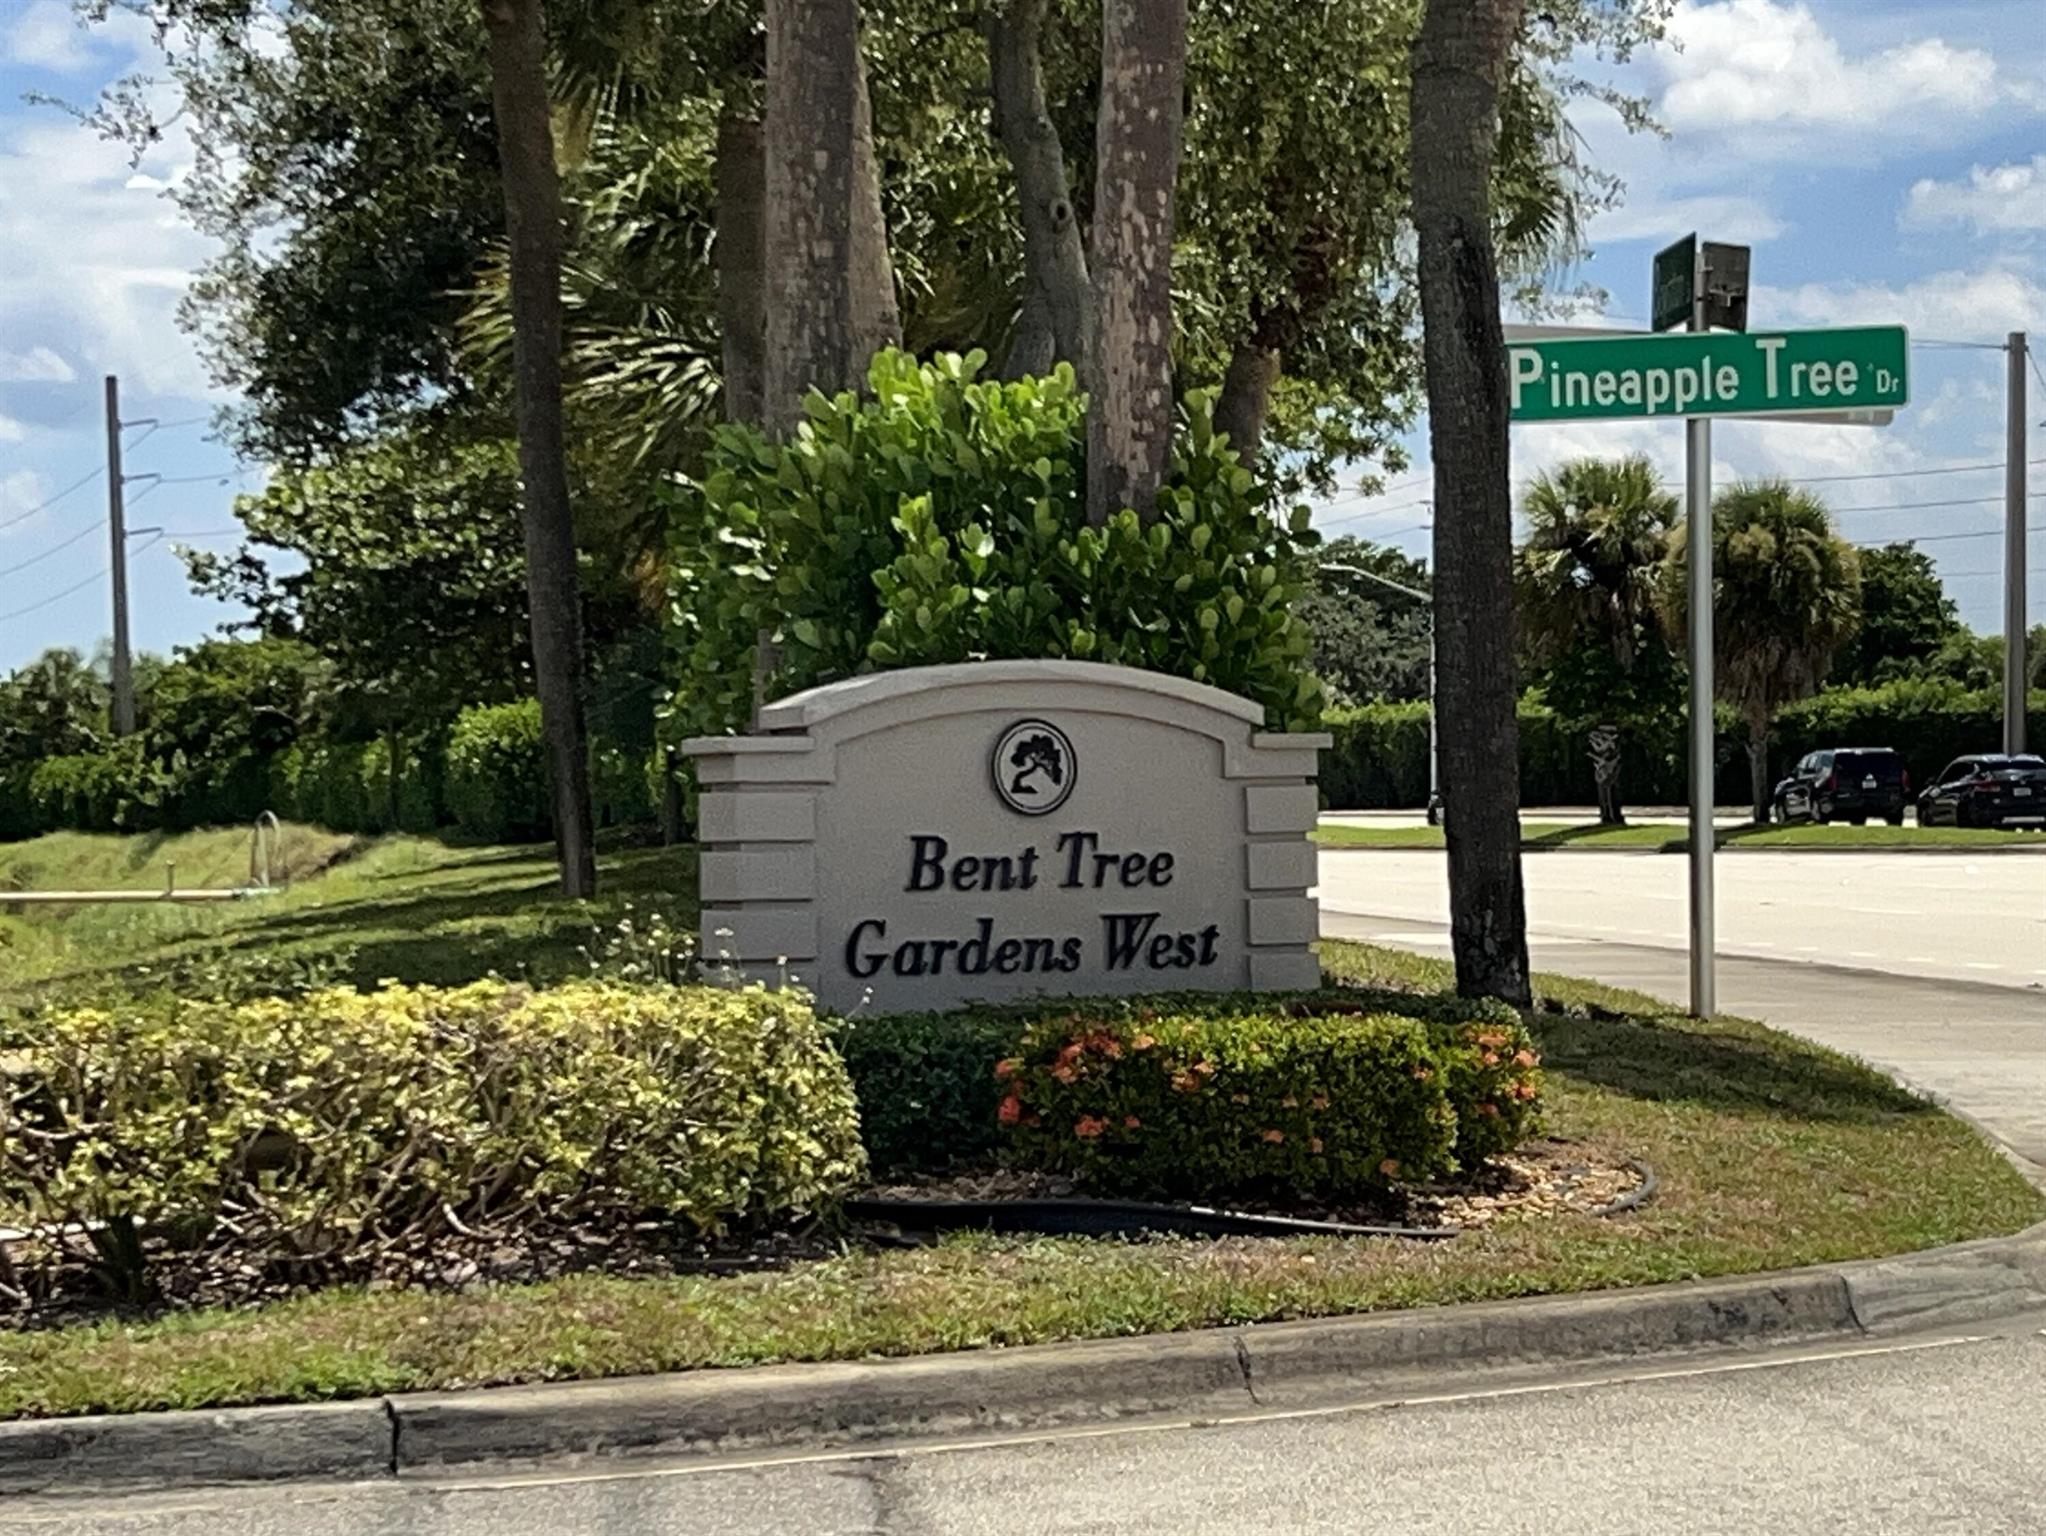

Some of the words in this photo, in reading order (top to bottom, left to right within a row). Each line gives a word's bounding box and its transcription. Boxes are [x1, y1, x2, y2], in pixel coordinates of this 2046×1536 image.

[1511, 348, 1739, 414] Pineapple
[1755, 338, 1859, 399] Tree
[1876, 369, 1899, 394] Dr
[904, 835, 1039, 892] Bent
[1056, 831, 1175, 889] Tree
[844, 918, 1082, 979] Gardens
[1101, 912, 1220, 971] West
